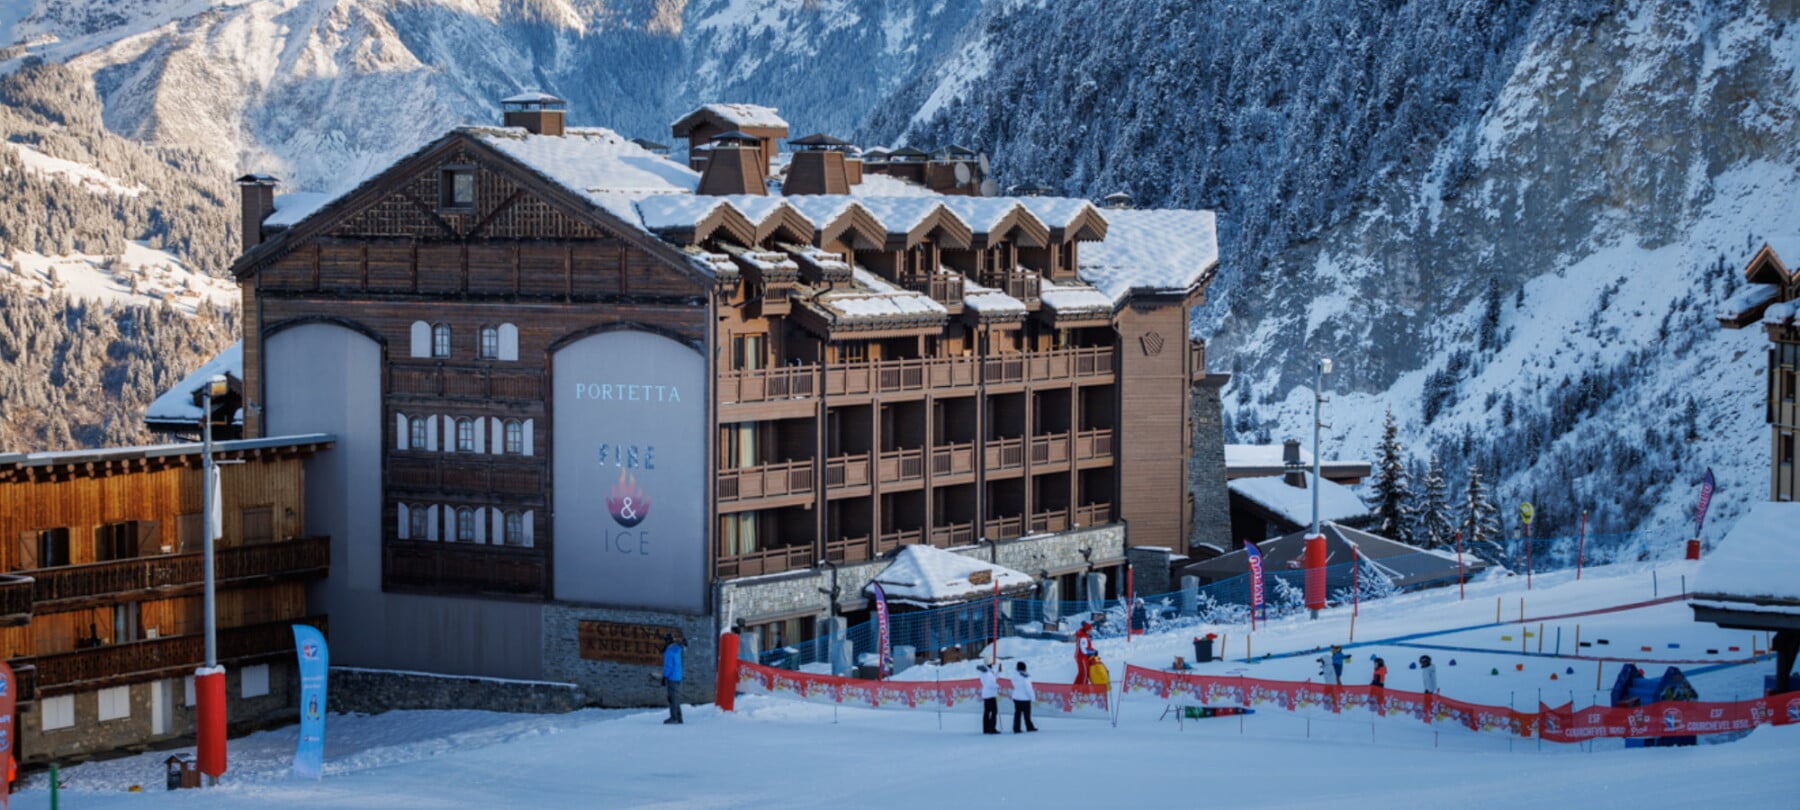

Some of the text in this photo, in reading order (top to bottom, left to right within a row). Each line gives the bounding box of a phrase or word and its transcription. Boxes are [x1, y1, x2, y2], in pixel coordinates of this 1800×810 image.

[576, 383, 681, 402] PORTETTA
[599, 444, 655, 470] FIRE
[620, 497, 637, 520] &
[605, 529, 649, 556] ICE
[585, 637, 663, 655] ANGELIN
